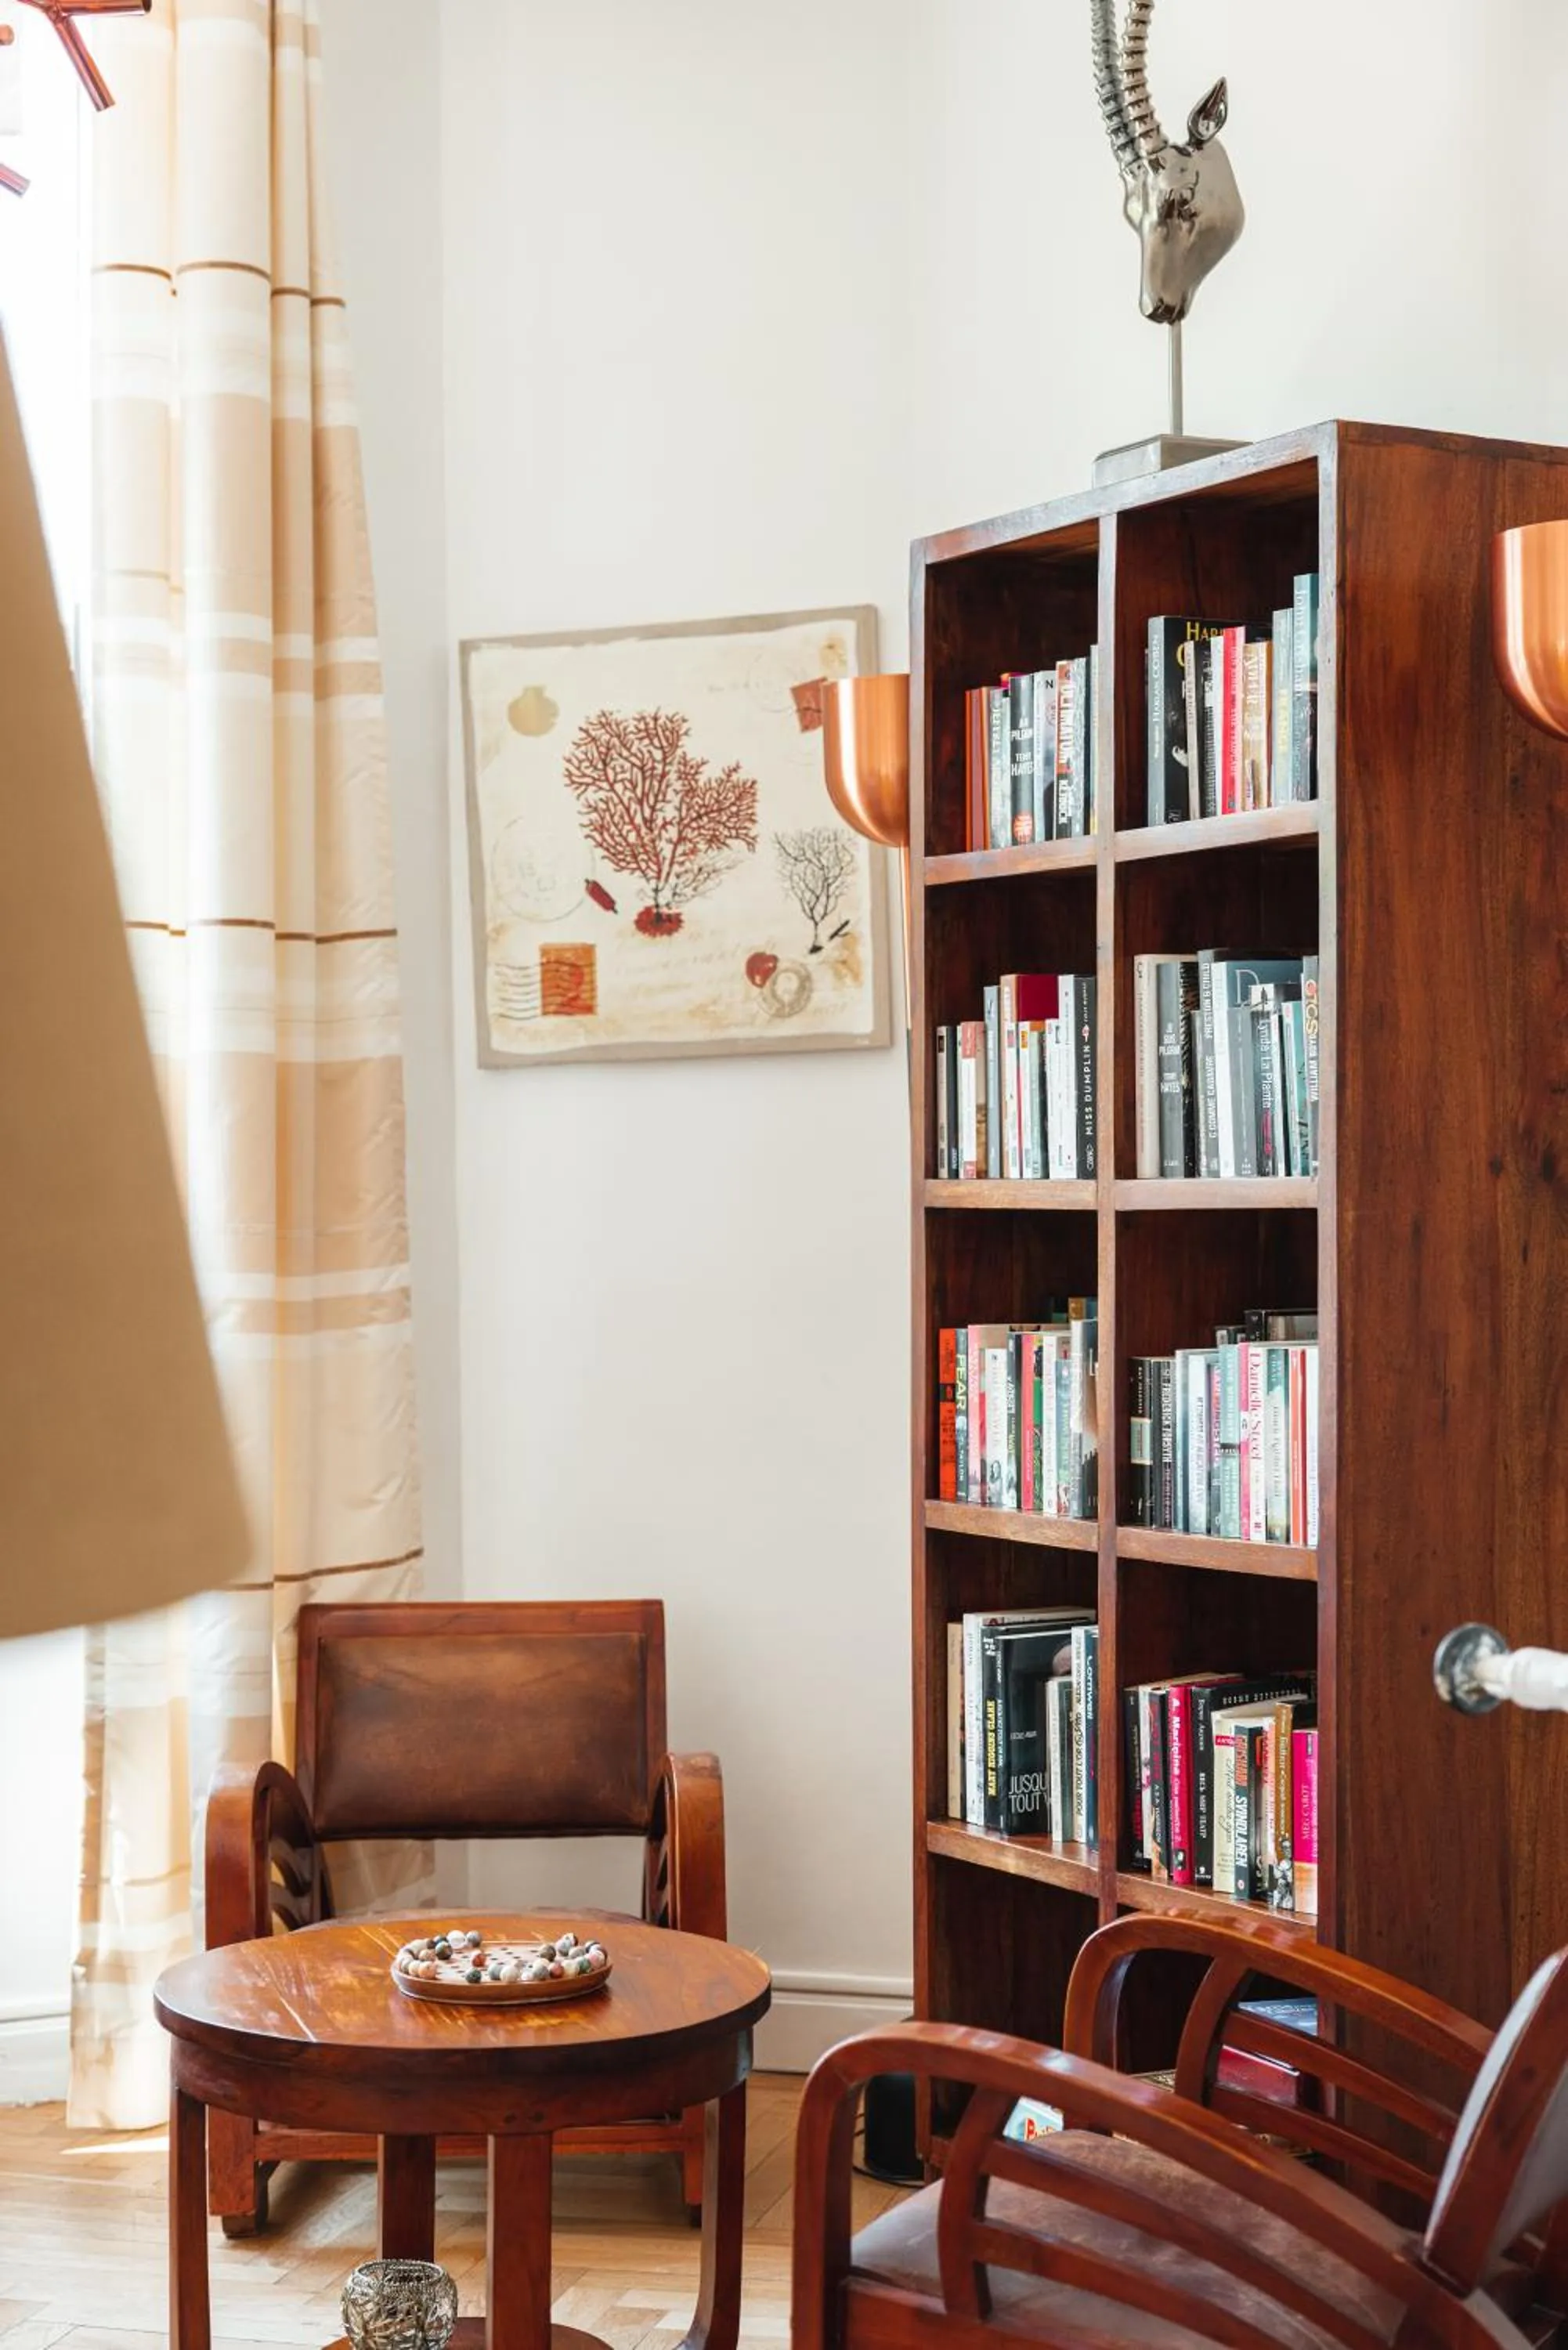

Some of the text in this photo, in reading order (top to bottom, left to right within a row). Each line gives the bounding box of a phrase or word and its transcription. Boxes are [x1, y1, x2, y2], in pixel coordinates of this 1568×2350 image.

[1295, 589, 1306, 627] John
[1305, 978, 1318, 1036] SOLO
[1257, 1019, 1270, 1052] Lynda
[1083, 1044, 1092, 1102] DUMPLIN
[1261, 1072, 1273, 1109] Plante
[1085, 1106, 1093, 1136] MISS
[956, 1353, 966, 1410] FEAR
[1249, 1352, 1263, 1418] Danielle
[1250, 1418, 1263, 1462] Steel
[986, 1699, 995, 1730] CLARK
[988, 1770, 997, 1796] MARY
[1009, 1772, 1048, 1794] JUSQU
[1008, 1792, 1042, 1813] TOUT
[1235, 1795, 1248, 1868] SVINDLAREN
